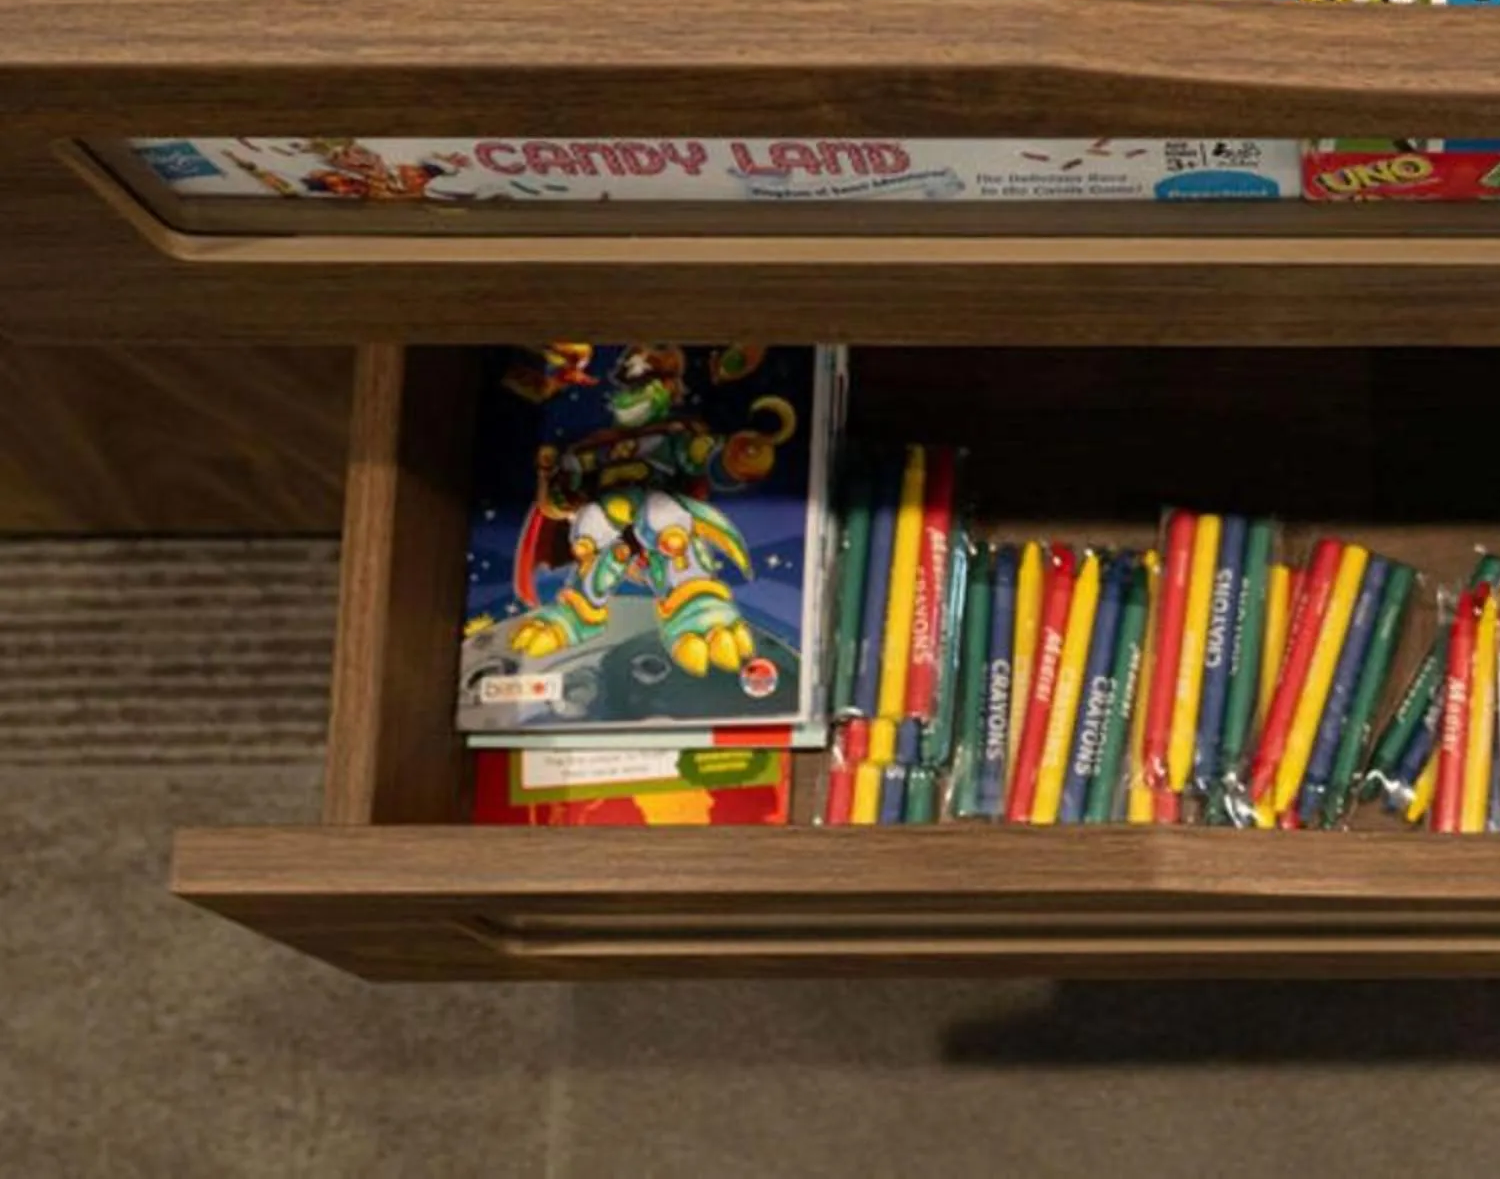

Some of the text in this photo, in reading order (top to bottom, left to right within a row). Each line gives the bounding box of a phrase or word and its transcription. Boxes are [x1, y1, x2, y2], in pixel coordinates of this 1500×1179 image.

[473, 141, 912, 176] CANDY LAND
[1315, 155, 1435, 194] UNO
[1205, 568, 1233, 669] CRAYONS
[986, 658, 1011, 762] CRAYONS
[1073, 675, 1108, 776] CRAYONS
